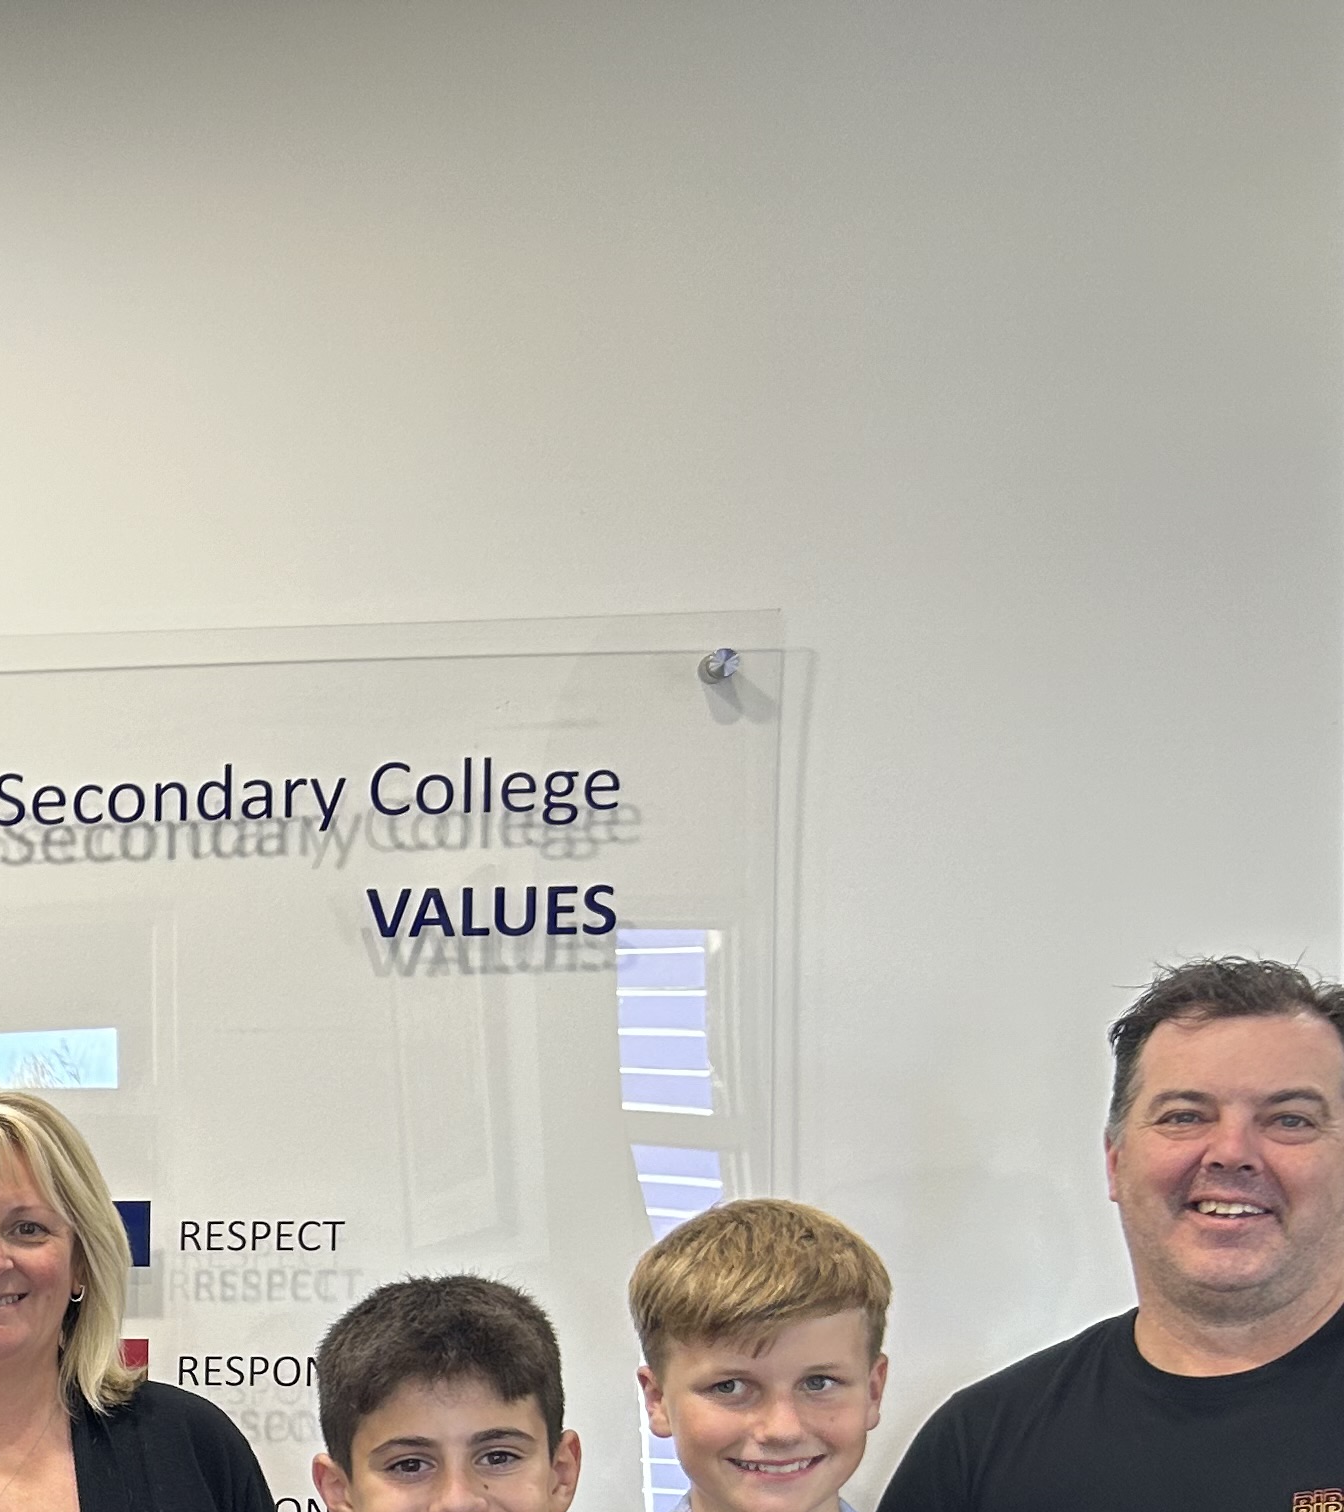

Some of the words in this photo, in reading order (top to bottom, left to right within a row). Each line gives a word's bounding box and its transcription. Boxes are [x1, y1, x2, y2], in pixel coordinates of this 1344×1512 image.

[368, 757, 622, 825] College
[367, 884, 617, 940] VALUES
[179, 1220, 346, 1252] RESPECT
